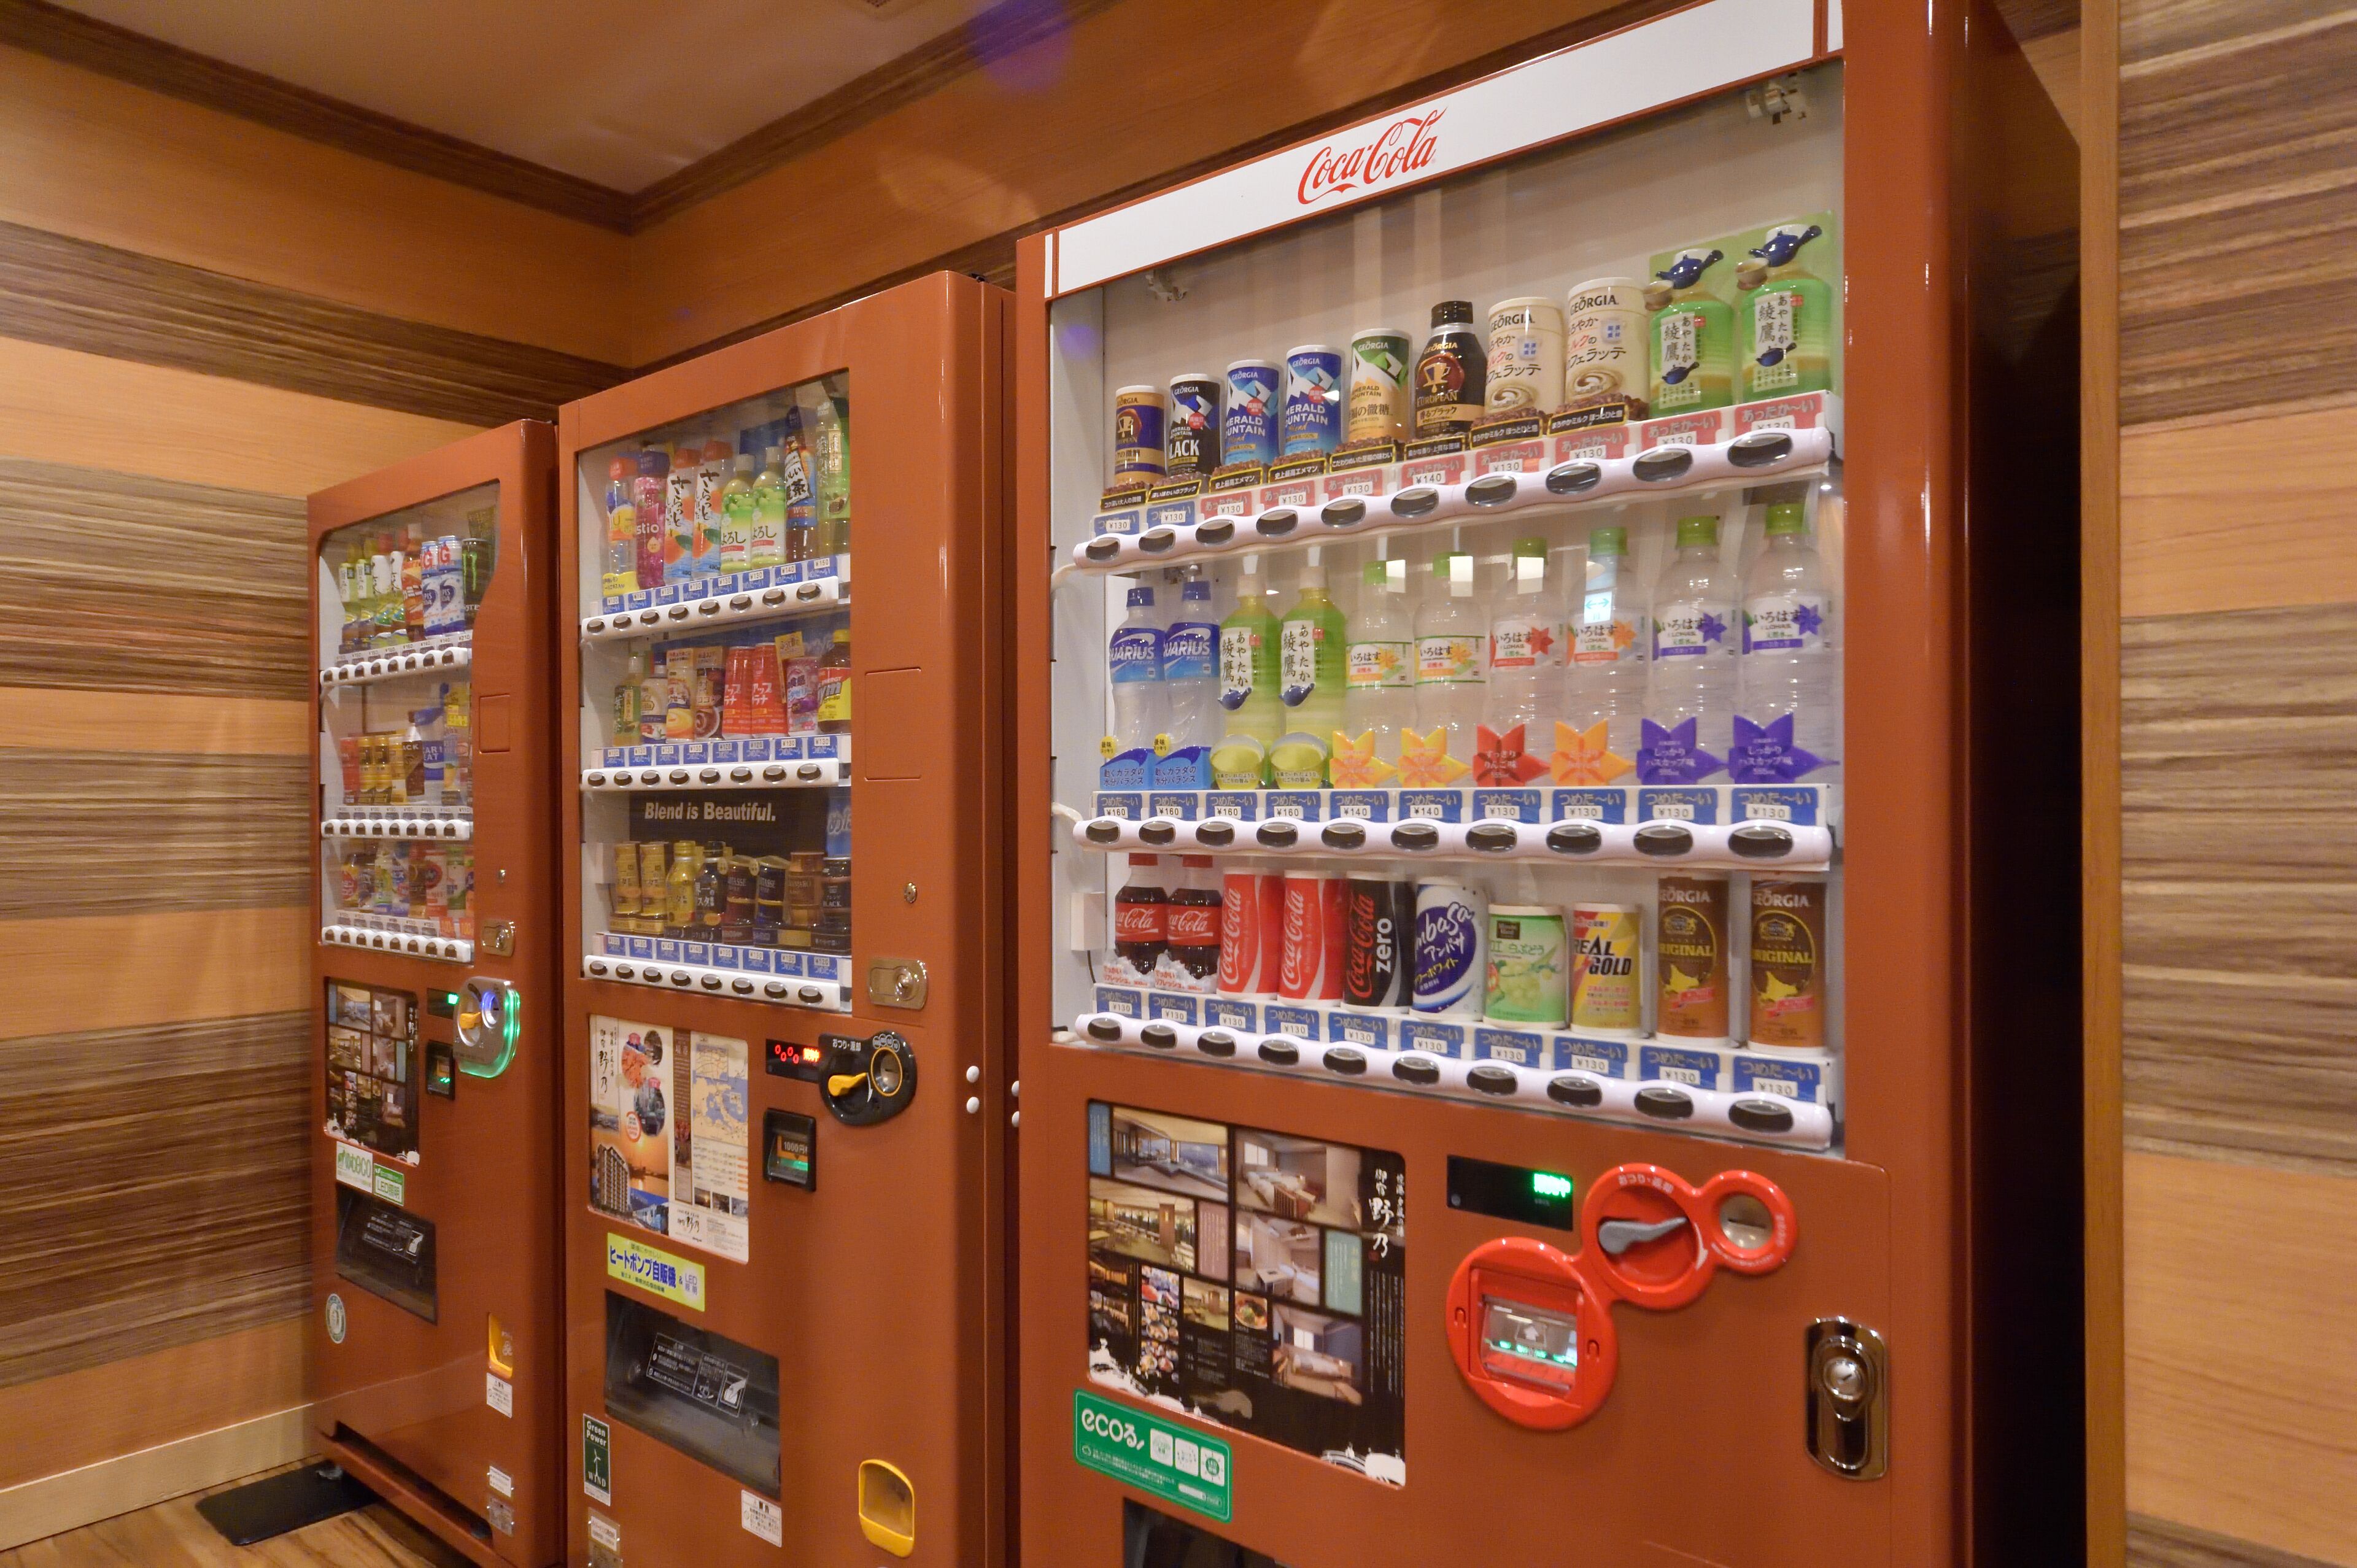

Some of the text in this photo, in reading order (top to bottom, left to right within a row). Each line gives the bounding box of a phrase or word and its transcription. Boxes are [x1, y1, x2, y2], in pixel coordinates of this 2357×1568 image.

[1297, 106, 1448, 205] Coca-Cola
[1758, 302, 1776, 344] 綾鷹
[1777, 295, 1789, 344] あやたか
[1663, 322, 1680, 363] 綾鷹
[1681, 315, 1692, 363] あやたか
[1169, 439, 1200, 459] LACK
[1415, 473, 1442, 484] ¥140
[1346, 484, 1370, 493] ¥130
[1281, 494, 1304, 504] ¥130
[1496, 631, 1535, 644] いろはす
[1576, 625, 1617, 638] いろはす
[1110, 646, 1155, 662] UARIUS
[1163, 640, 1210, 657] UARIUS
[1282, 631, 1297, 678] 綾鷹
[1298, 625, 1311, 682] あやたか
[1420, 646, 1453, 657] いろはす
[1221, 637, 1236, 682] 綾鷹
[1236, 631, 1249, 687] あやたか
[1350, 652, 1382, 663] いろはす
[644, 801, 776, 821] Blend is Beautiful.
[1106, 808, 1126, 816] ¥160
[1159, 807, 1180, 816] ¥160
[1217, 807, 1239, 816] ¥160
[1277, 808, 1299, 817] ¥160
[1342, 807, 1368, 817] ¥140
[1414, 807, 1439, 816] ¥140
[1489, 806, 1516, 816] ¥130
[1569, 808, 1597, 817] ¥130
[1658, 808, 1689, 817] ¥130
[1752, 807, 1786, 819] ¥130
[1220, 887, 1242, 985] Coca-Cola
[1280, 889, 1304, 991] Coca-Cola
[1346, 893, 1375, 998] Coca-Cola
[1376, 917, 1393, 973] zero
[1658, 944, 1712, 956] RIGINAL
[1752, 948, 1813, 964] RIGINAL
[1589, 956, 1632, 976] GOLD
[1112, 1003, 1131, 1013] ¥130
[1166, 1010, 1185, 1021] ¥130
[1222, 1016, 1243, 1027] ¥130
[1283, 1024, 1306, 1035] ¥130
[1348, 1032, 1372, 1042] ¥130
[1417, 1040, 1442, 1051] ¥130
[1495, 1049, 1523, 1060] ¥130
[1575, 1058, 1606, 1071] ¥130
[1665, 1070, 1697, 1083] ¥130
[1757, 1082, 1793, 1095] ¥130
[610, 1245, 676, 1289] ヒートポンプ自販機
[587, 1420, 606, 1437] Green
[587, 1429, 607, 1447] Power
[588, 1470, 606, 1488] WIND
